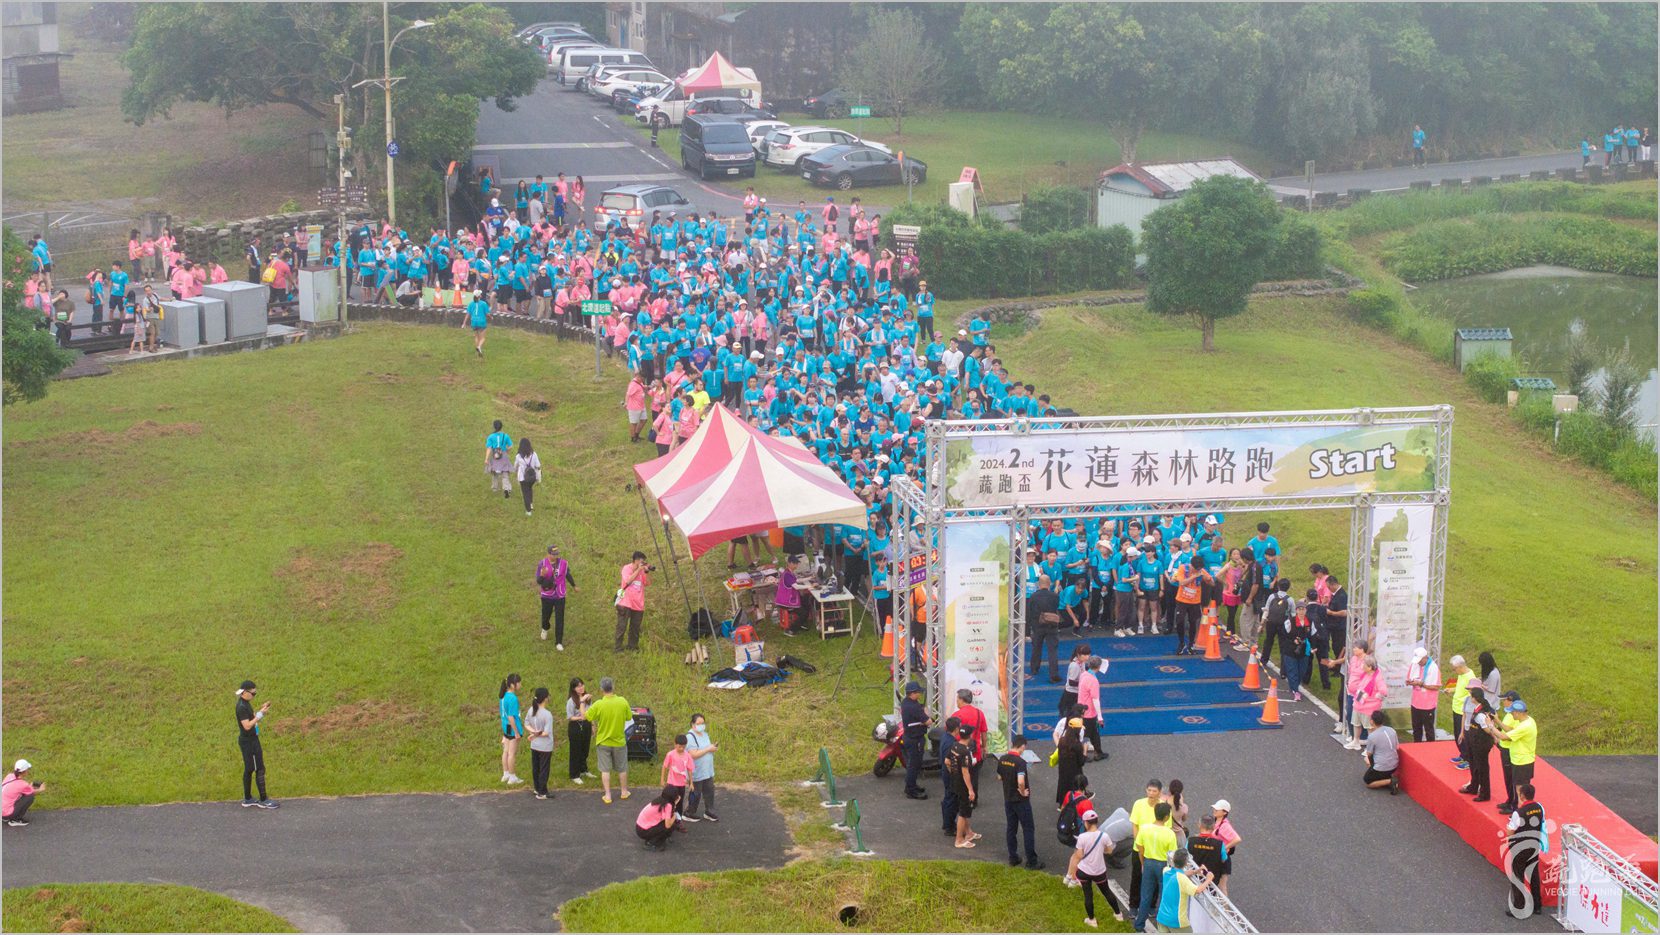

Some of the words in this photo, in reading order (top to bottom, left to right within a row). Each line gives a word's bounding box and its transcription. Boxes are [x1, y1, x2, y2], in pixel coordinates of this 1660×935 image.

[1039, 445, 1274, 491] 花蓮森林路跑
[1308, 441, 1397, 480] Start
[979, 473, 1032, 495] 蔬跑盃
